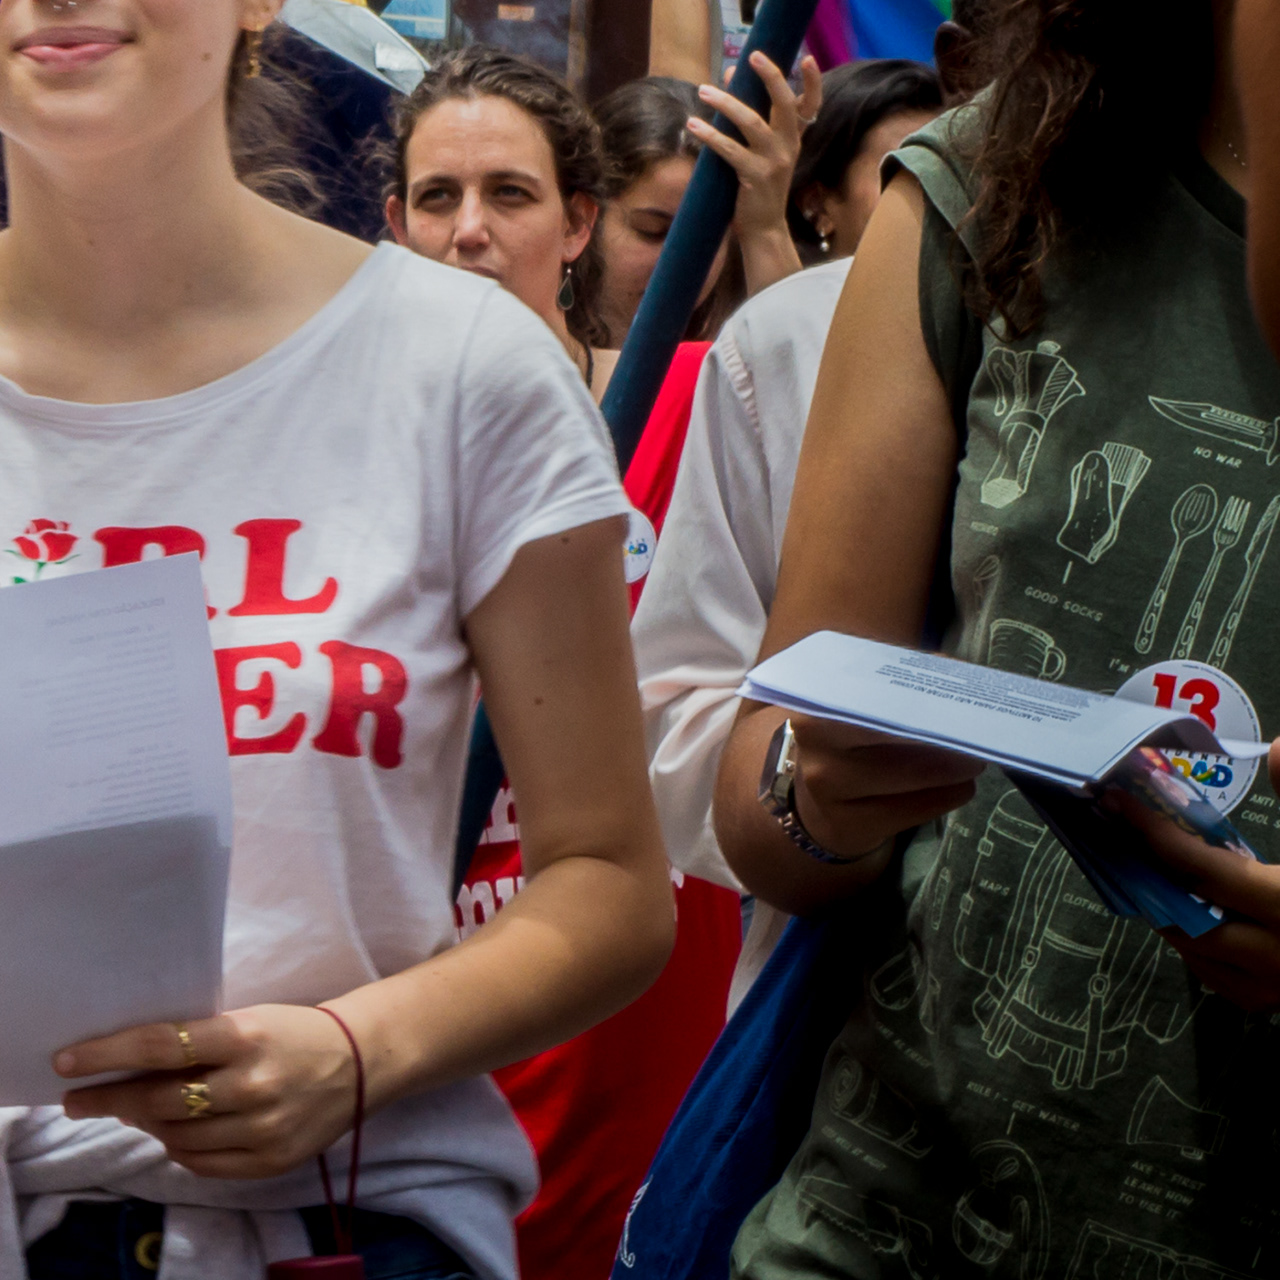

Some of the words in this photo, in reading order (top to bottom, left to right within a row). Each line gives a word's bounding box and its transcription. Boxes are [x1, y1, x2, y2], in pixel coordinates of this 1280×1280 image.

[1193, 446, 1210, 460] NO
[1215, 453, 1242, 469] WAR
[1024, 586, 1059, 606] GOOD
[1062, 600, 1104, 622] SOCKS
[1152, 673, 1220, 732] 13
[1249, 793, 1275, 807] ANTI
[1241, 809, 1269, 826] COOL
[979, 878, 1011, 897] MAPS
[1038, 1109, 1081, 1133] WATER
[1123, 1175, 1163, 1196] LEARN
[1165, 1190, 1195, 1207] HOW
[1170, 1173, 1207, 1191] FIRST
[1118, 1191, 1136, 1205] TO
[1138, 1198, 1164, 1215] USE
